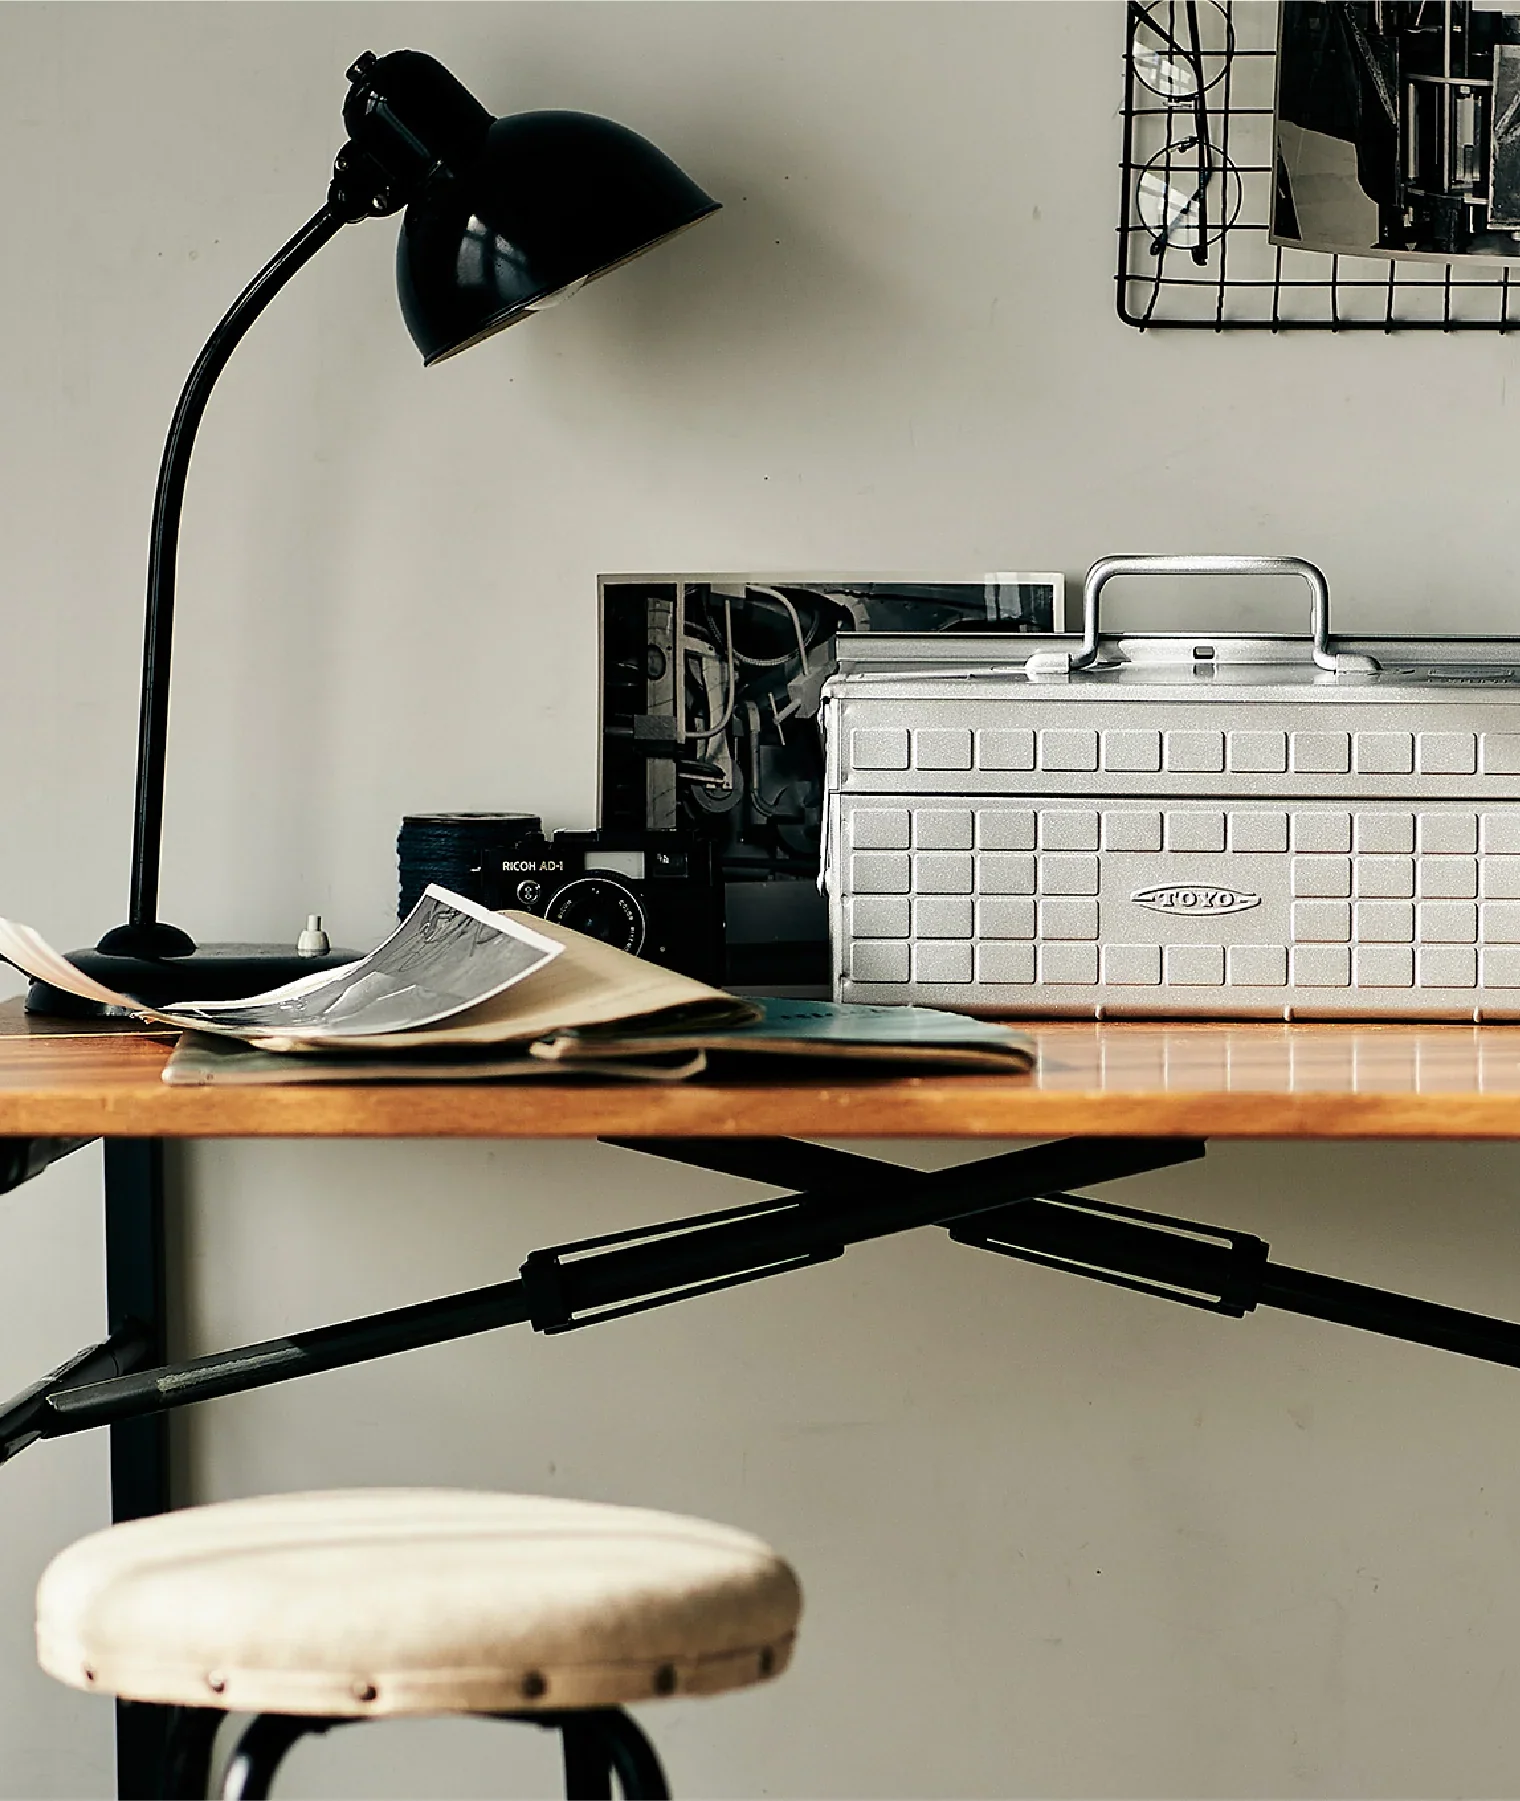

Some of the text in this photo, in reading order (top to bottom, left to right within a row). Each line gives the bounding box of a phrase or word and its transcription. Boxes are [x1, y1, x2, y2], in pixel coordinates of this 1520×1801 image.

[502, 861, 564, 871] RICOH AD-1
[1158, 891, 1236, 908] TOYO
